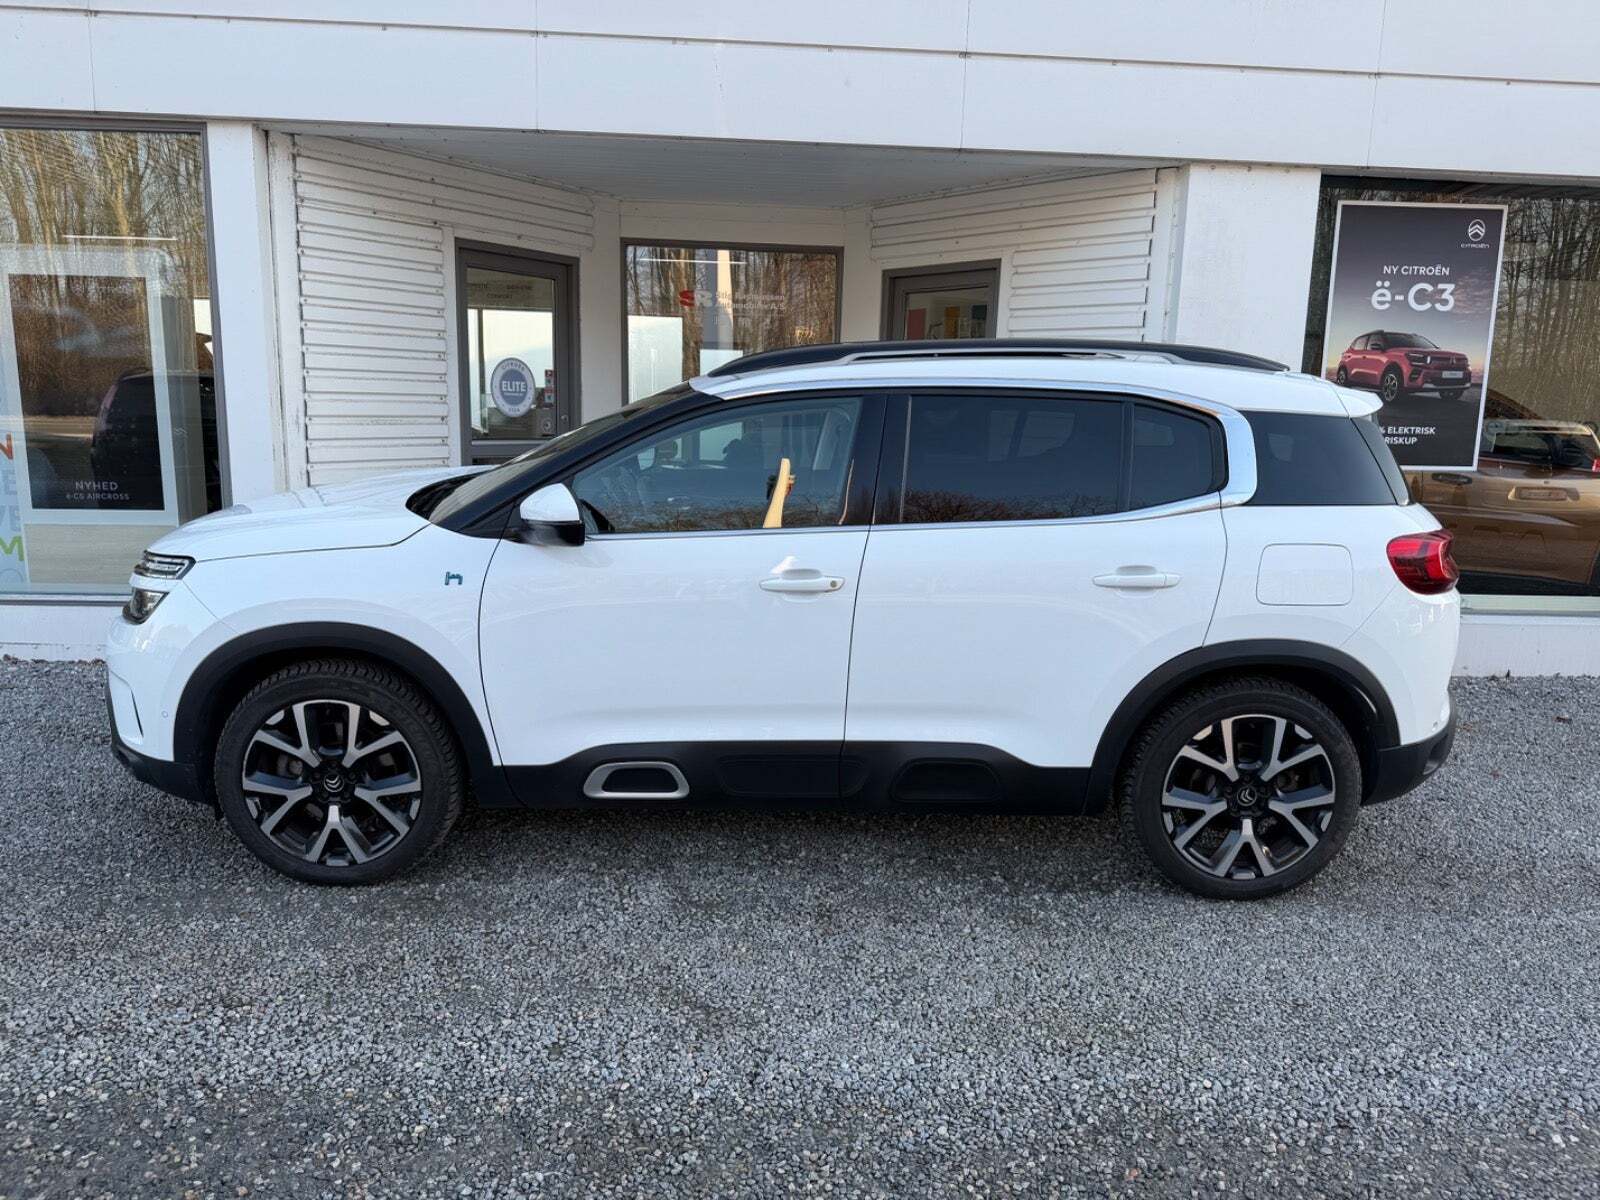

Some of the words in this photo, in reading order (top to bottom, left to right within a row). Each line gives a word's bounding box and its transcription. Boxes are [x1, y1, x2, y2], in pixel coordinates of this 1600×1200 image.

[1383, 265, 1399, 275] NY
[1401, 263, 1450, 276] CITROËN
[1371, 280, 1456, 311] ë-C3
[502, 380, 527, 392] ELITE
[1387, 426, 1436, 435] ELEKTRISK
[1385, 436, 1418, 445] RISKUP
[75, 481, 119, 491] NYHED
